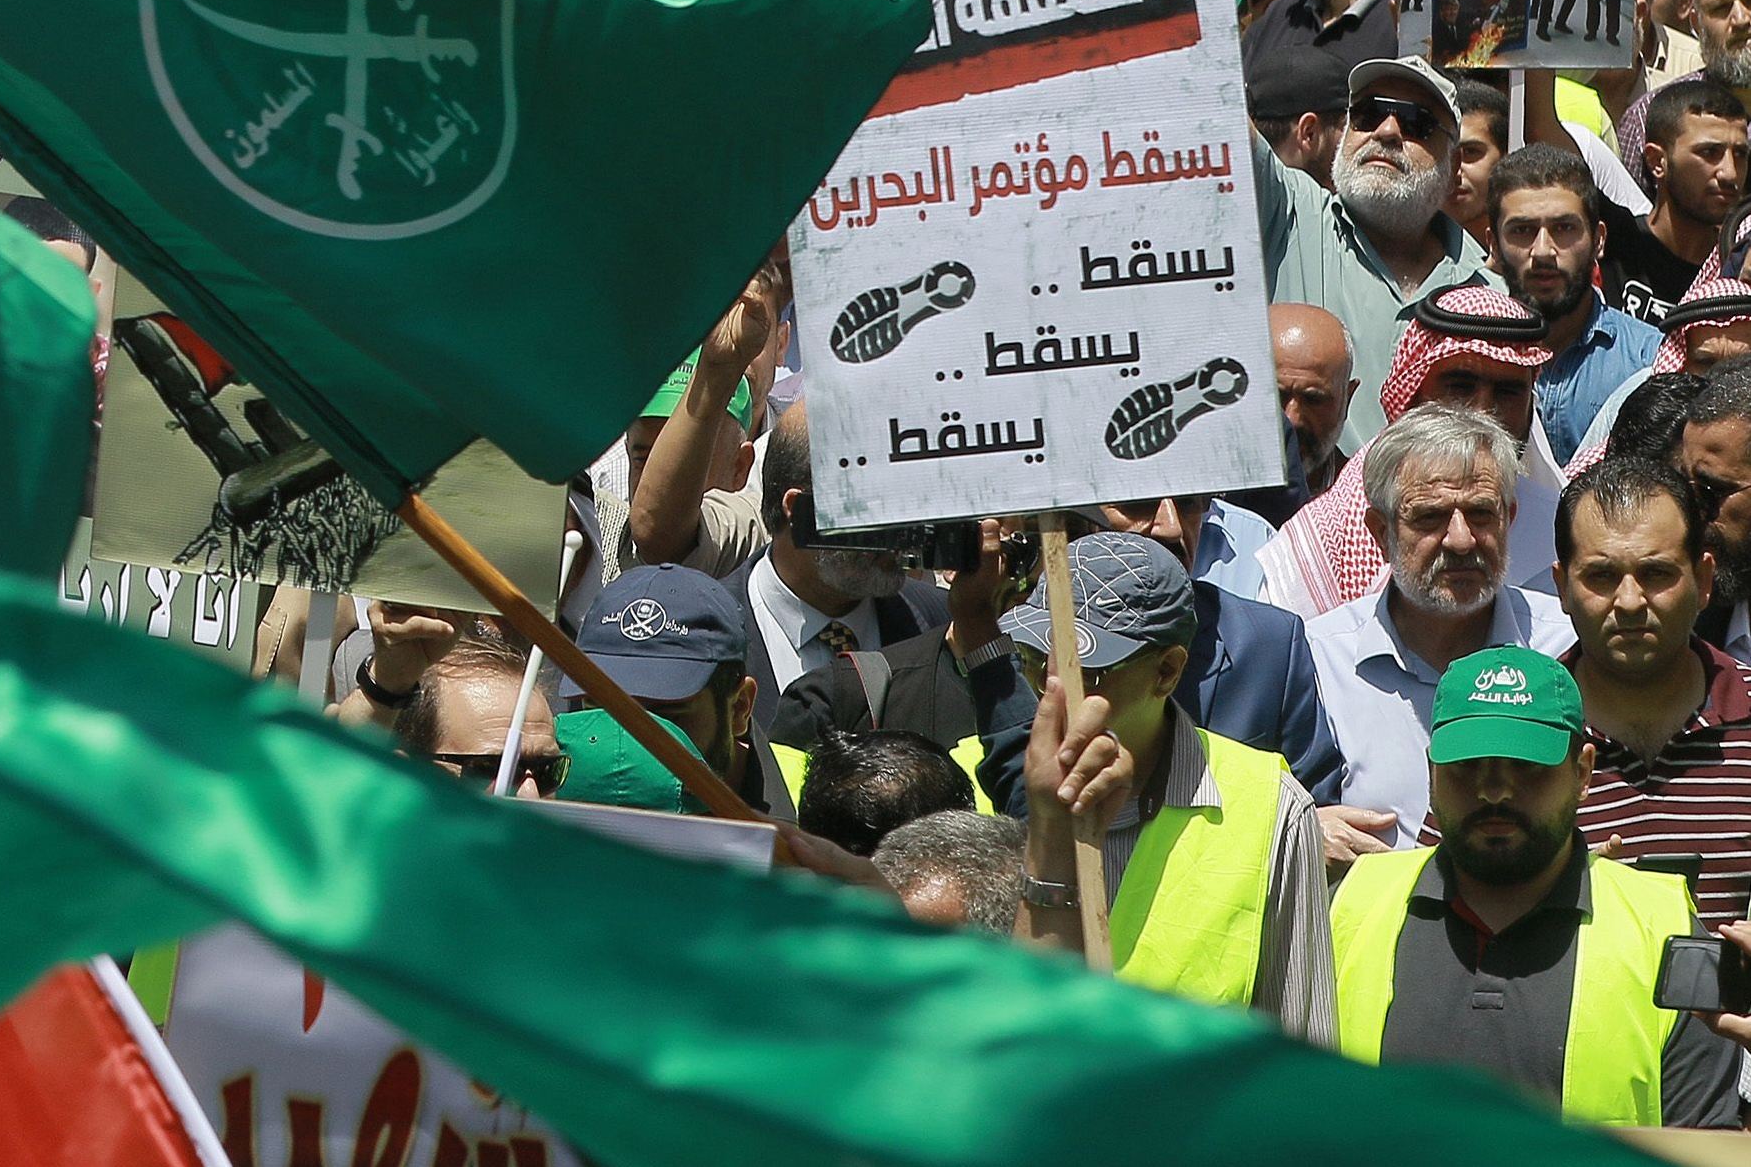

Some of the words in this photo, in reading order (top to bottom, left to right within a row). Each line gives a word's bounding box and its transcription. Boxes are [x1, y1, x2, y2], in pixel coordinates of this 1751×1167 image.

[969, 133, 1089, 217] مؤتمر
[1100, 130, 1231, 194] يسقط
[808, 145, 955, 231] البحرين
[1080, 241, 1234, 292] يسقط
[984, 326, 1140, 377] يسقط
[888, 412, 1045, 464] يسقط
[145, 566, 182, 639] لا
[1467, 691, 1501, 703] النصر
[1474, 665, 1527, 691] القدس
[1502, 691, 1534, 706] بوابة
